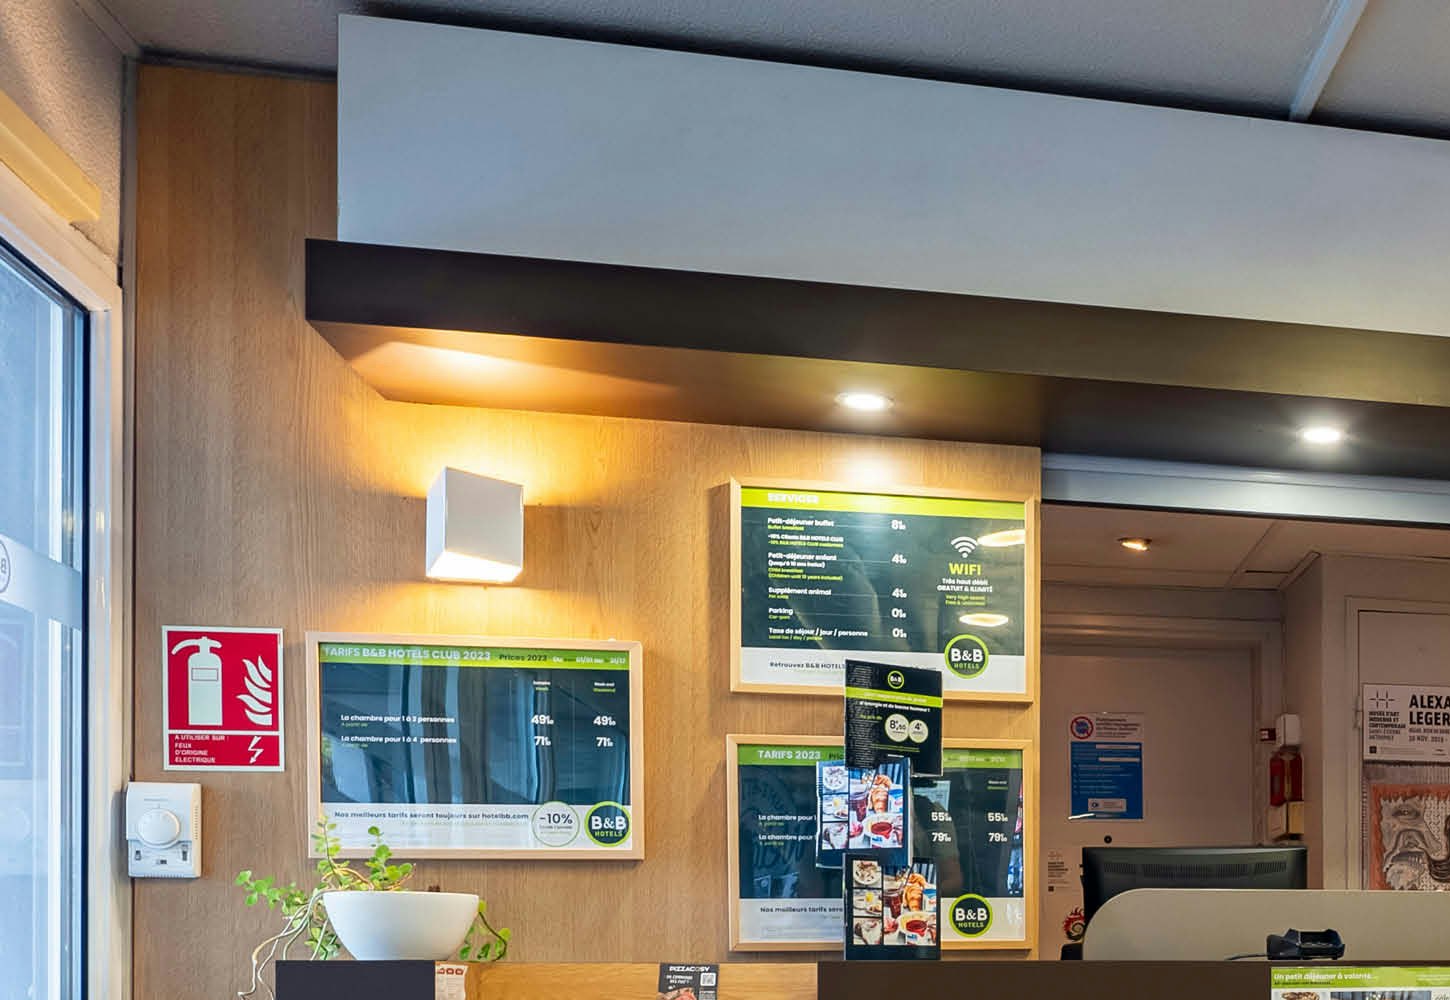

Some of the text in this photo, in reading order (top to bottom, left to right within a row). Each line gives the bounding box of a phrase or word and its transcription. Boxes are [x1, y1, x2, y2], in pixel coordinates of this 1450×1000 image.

[767, 493, 819, 504] SERVICES
[948, 562, 981, 576] WIFI
[768, 607, 794, 615] Parking
[837, 630, 868, 638] personne
[325, 647, 360, 657] TARIFS
[362, 648, 386, 657] B&B
[388, 648, 429, 659] HOTELS
[431, 650, 460, 660] CLUB
[950, 648, 984, 663] B&B
[953, 662, 980, 670] HOTELS
[350, 714, 383, 722] chambre
[383, 716, 401, 724] pour
[1409, 711, 1450, 726] LEGER
[350, 735, 383, 743] chambre
[419, 736, 457, 745] personnes
[757, 750, 793, 759] TARIFS
[795, 751, 821, 760] 2023
[387, 811, 408, 819] tarifs
[409, 811, 434, 819] seront
[435, 812, 466, 820] toujours
[481, 812, 530, 820] hotelbb.com
[539, 813, 573, 825] -10%
[591, 815, 627, 830] B&B
[955, 907, 988, 922] B&B
